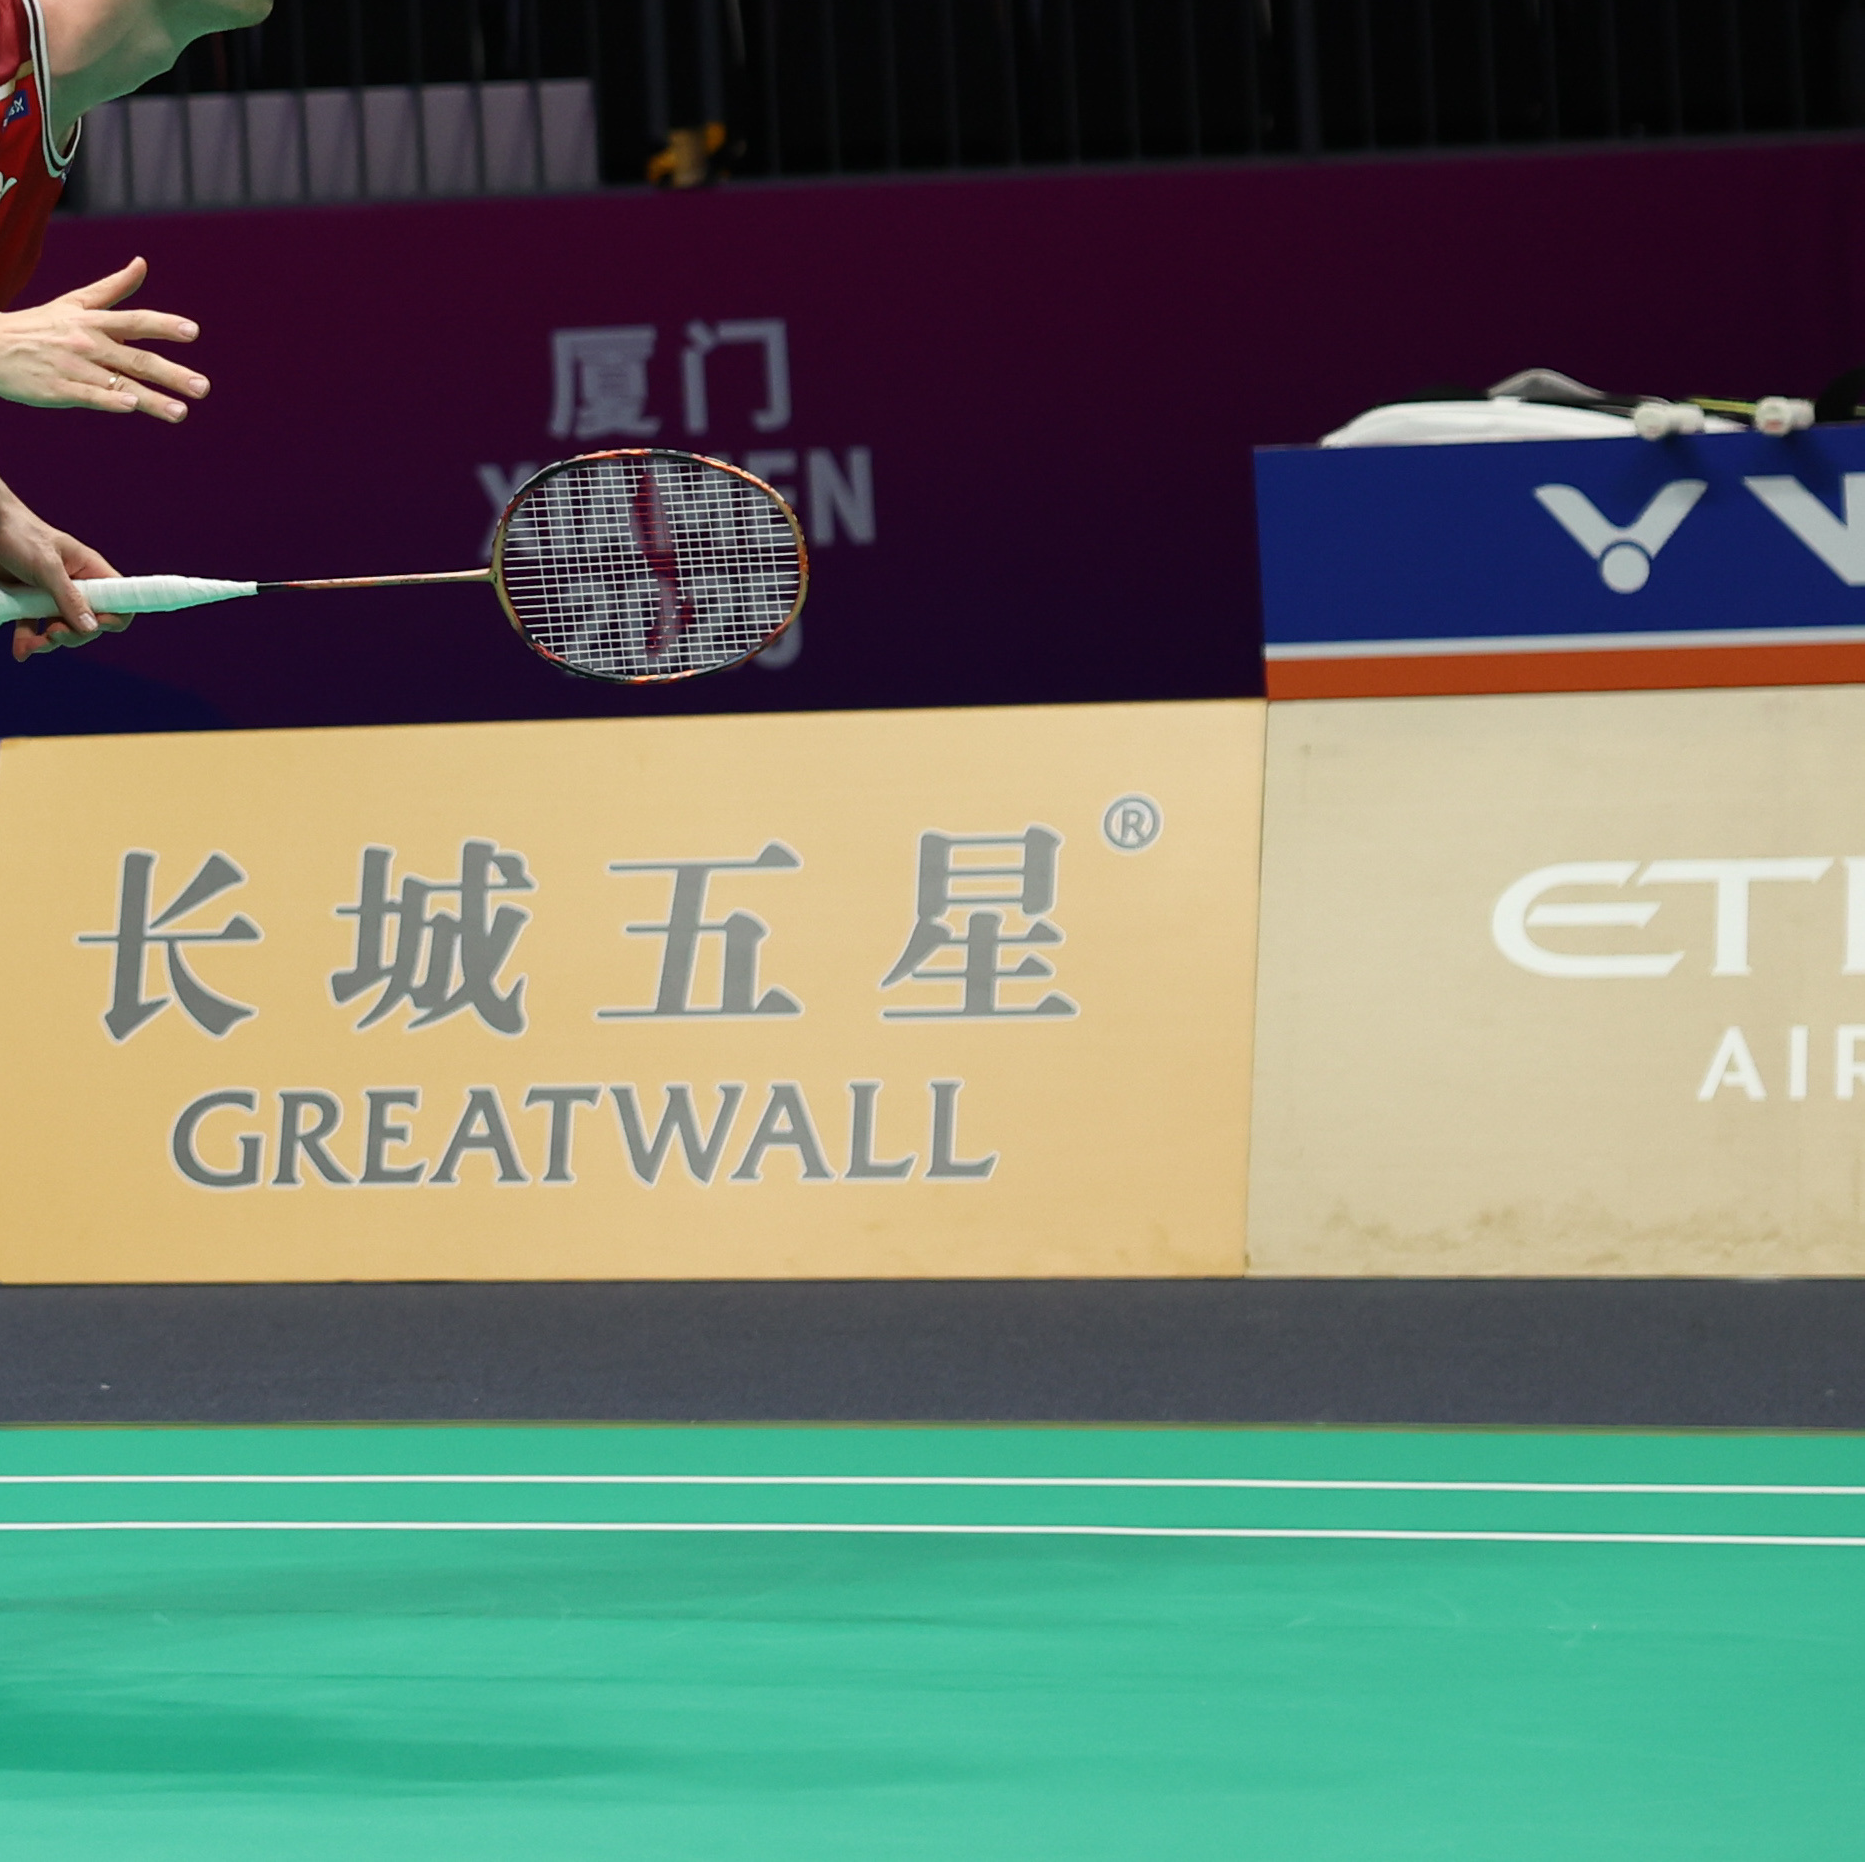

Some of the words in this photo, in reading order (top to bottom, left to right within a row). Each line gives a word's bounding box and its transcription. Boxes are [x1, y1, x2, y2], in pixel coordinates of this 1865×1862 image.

[548, 317, 792, 439] 厦门
[76, 824, 1080, 1041] 长城五星
[1491, 856, 1865, 979] ETI
[1697, 1023, 1865, 1102] AIR
[170, 1081, 999, 1188] GREATWALL
